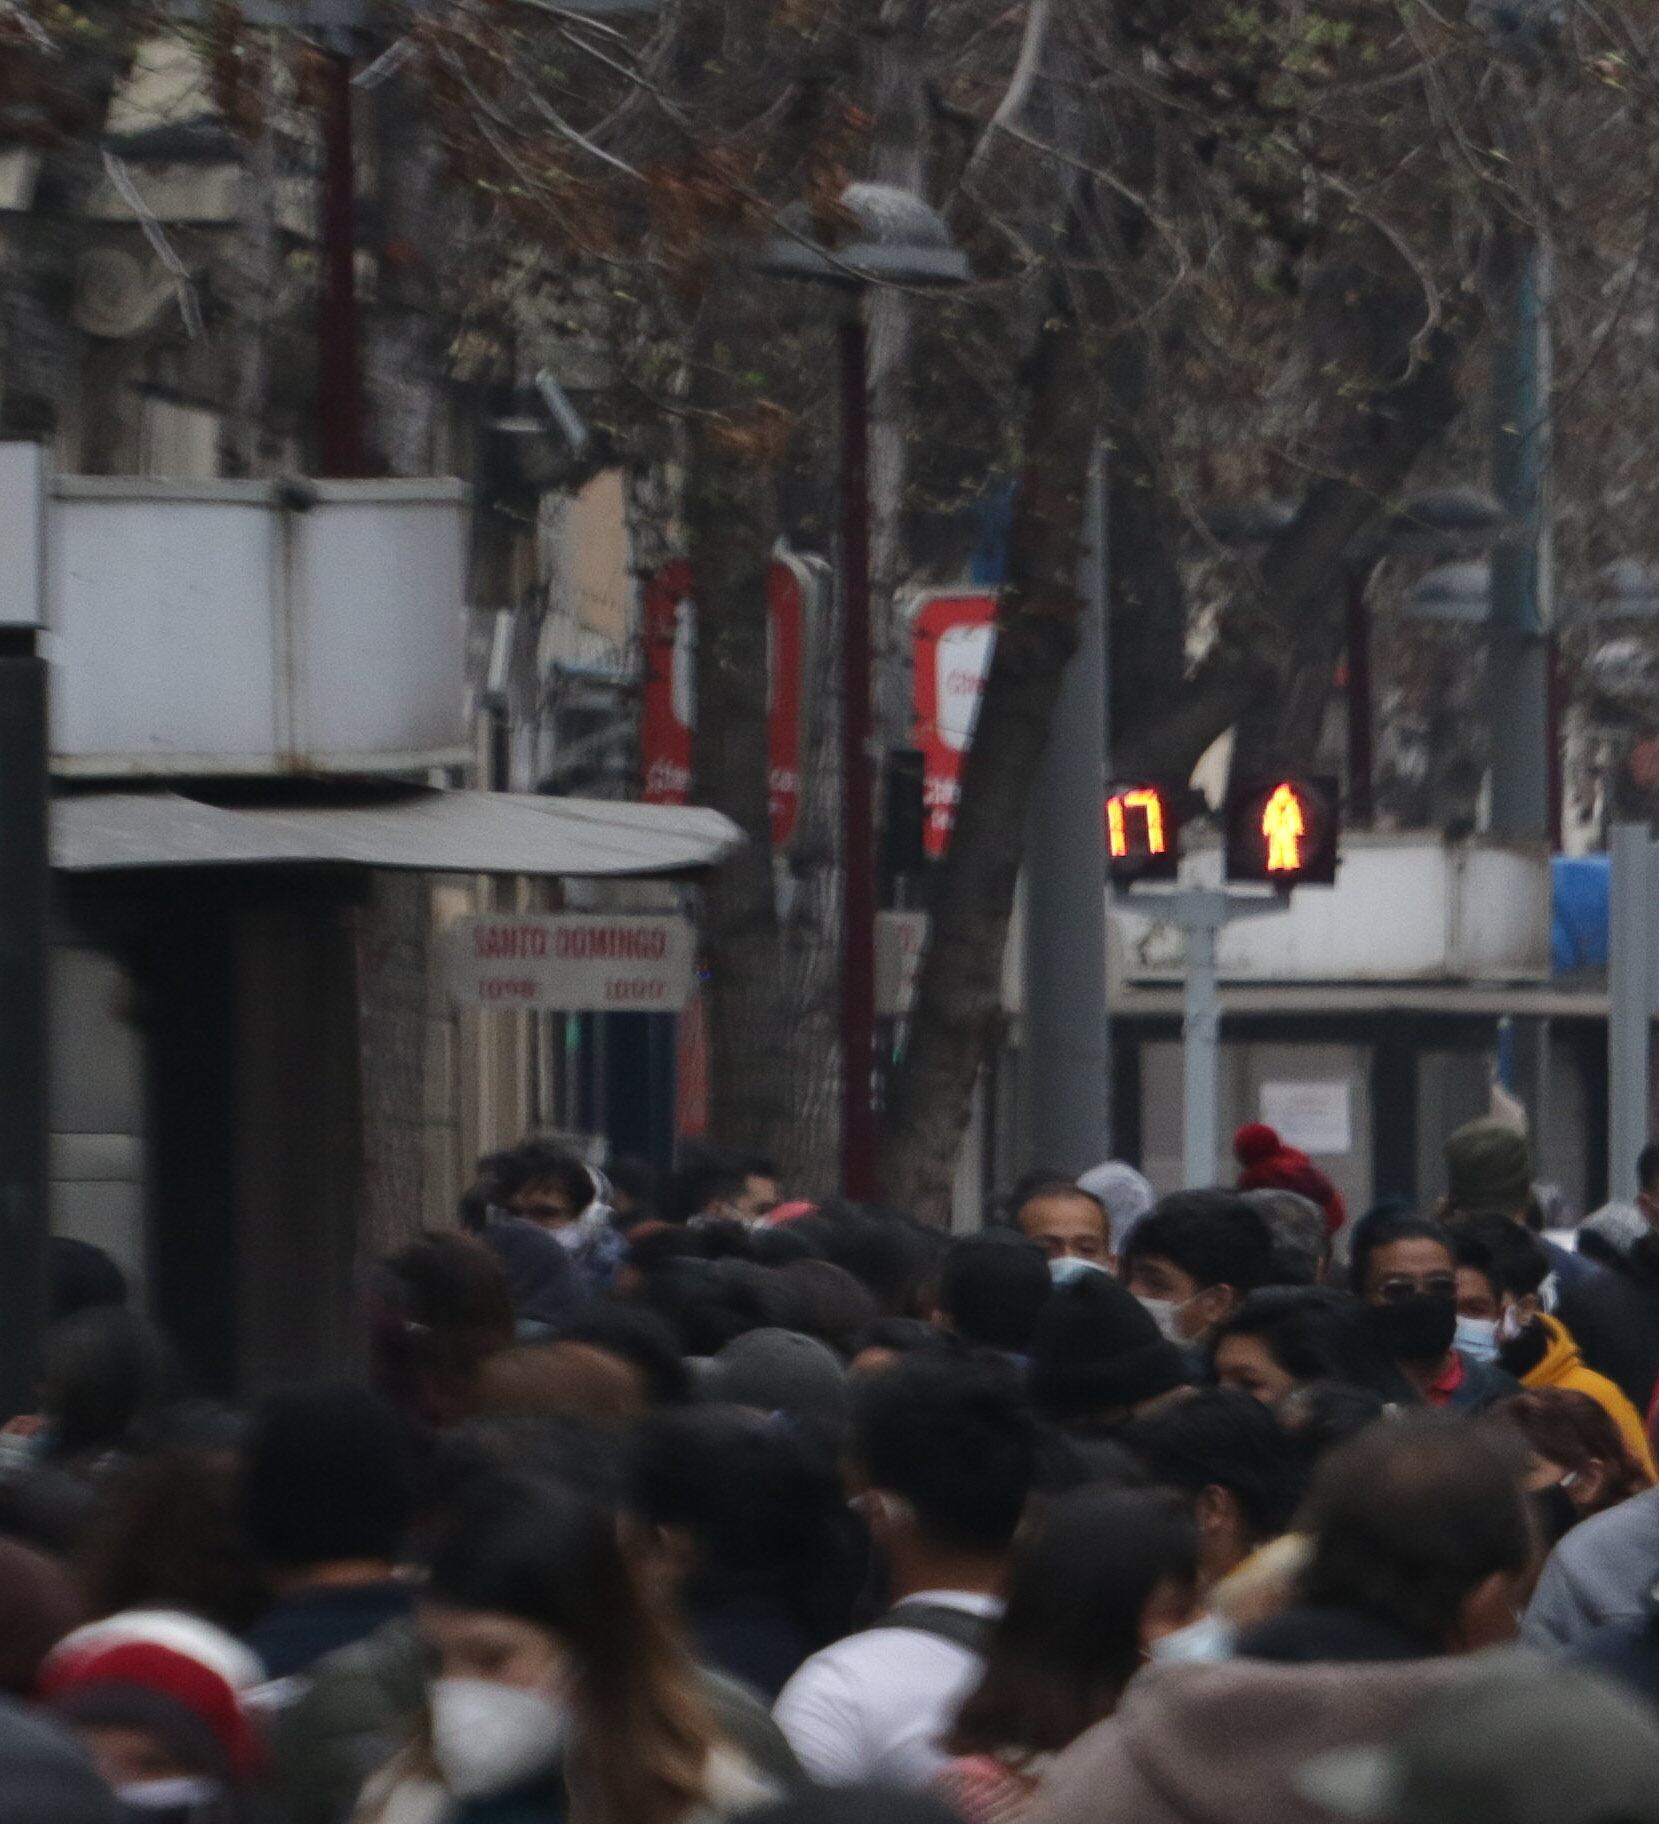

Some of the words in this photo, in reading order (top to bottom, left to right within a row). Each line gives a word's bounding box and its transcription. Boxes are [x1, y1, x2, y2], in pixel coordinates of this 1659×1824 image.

[1106, 789, 1167, 857] 17
[474, 926, 547, 958] SANTO
[557, 927, 667, 959] DOMINGO
